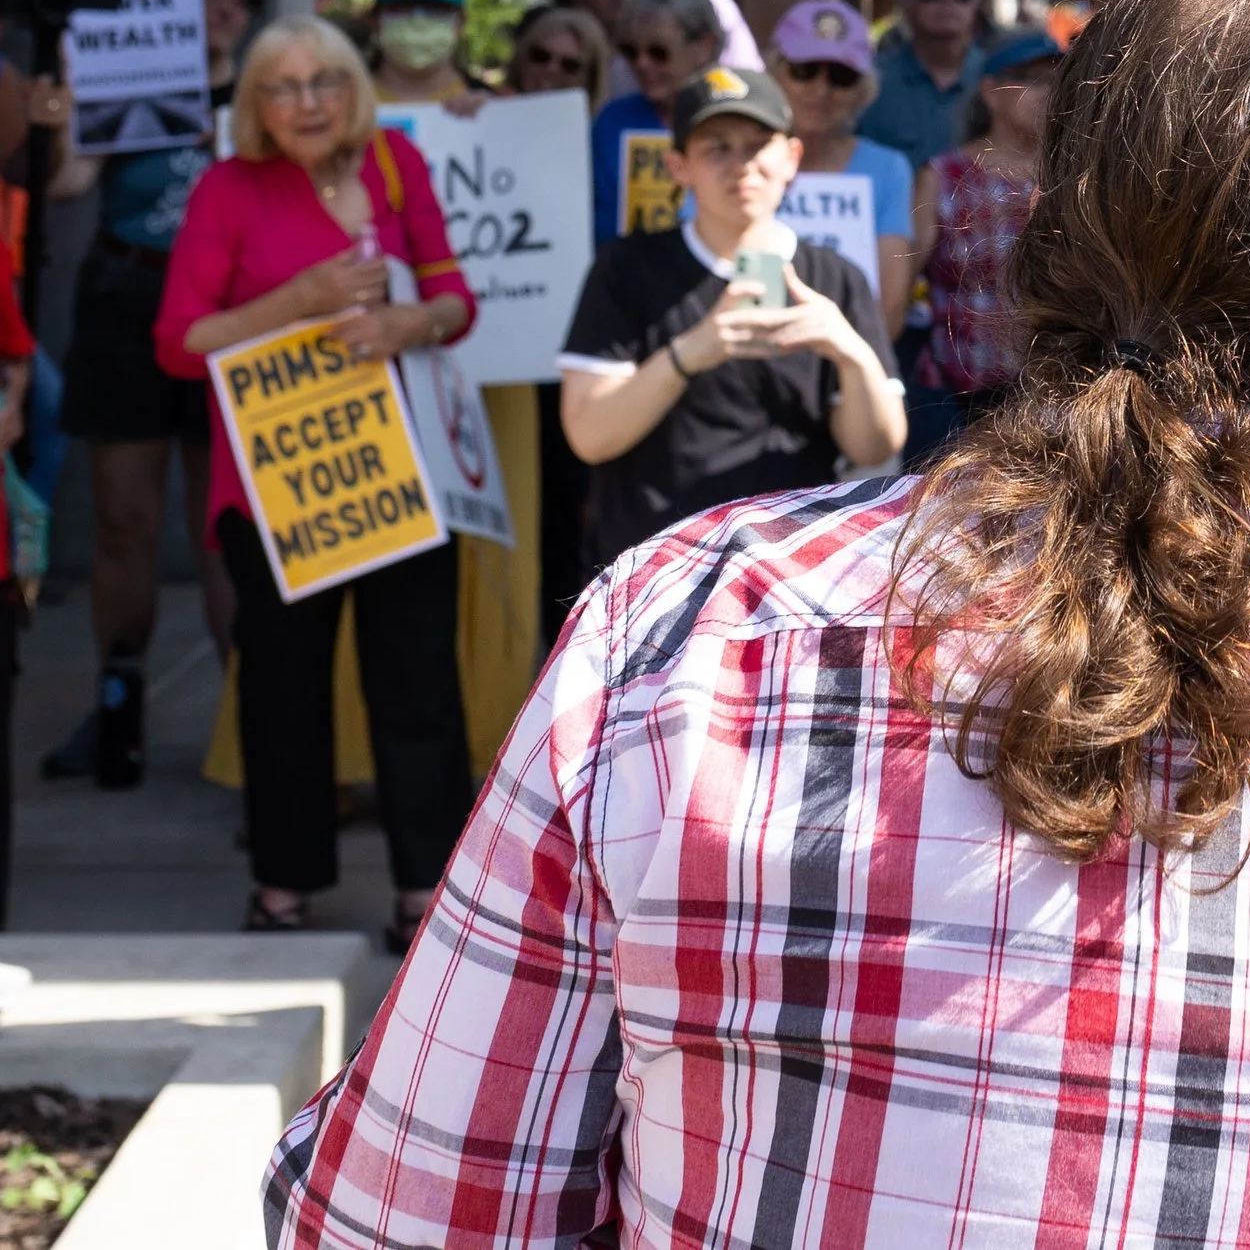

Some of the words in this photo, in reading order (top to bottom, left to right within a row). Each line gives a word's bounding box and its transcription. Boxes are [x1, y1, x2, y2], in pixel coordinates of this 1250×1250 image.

[76, 22, 198, 51] WEALTH
[445, 144, 516, 202] No
[228, 335, 364, 407] PHMS
[251, 389, 391, 470] ACCEPT
[283, 444, 387, 507] YOUR
[273, 478, 429, 565] MISSION
